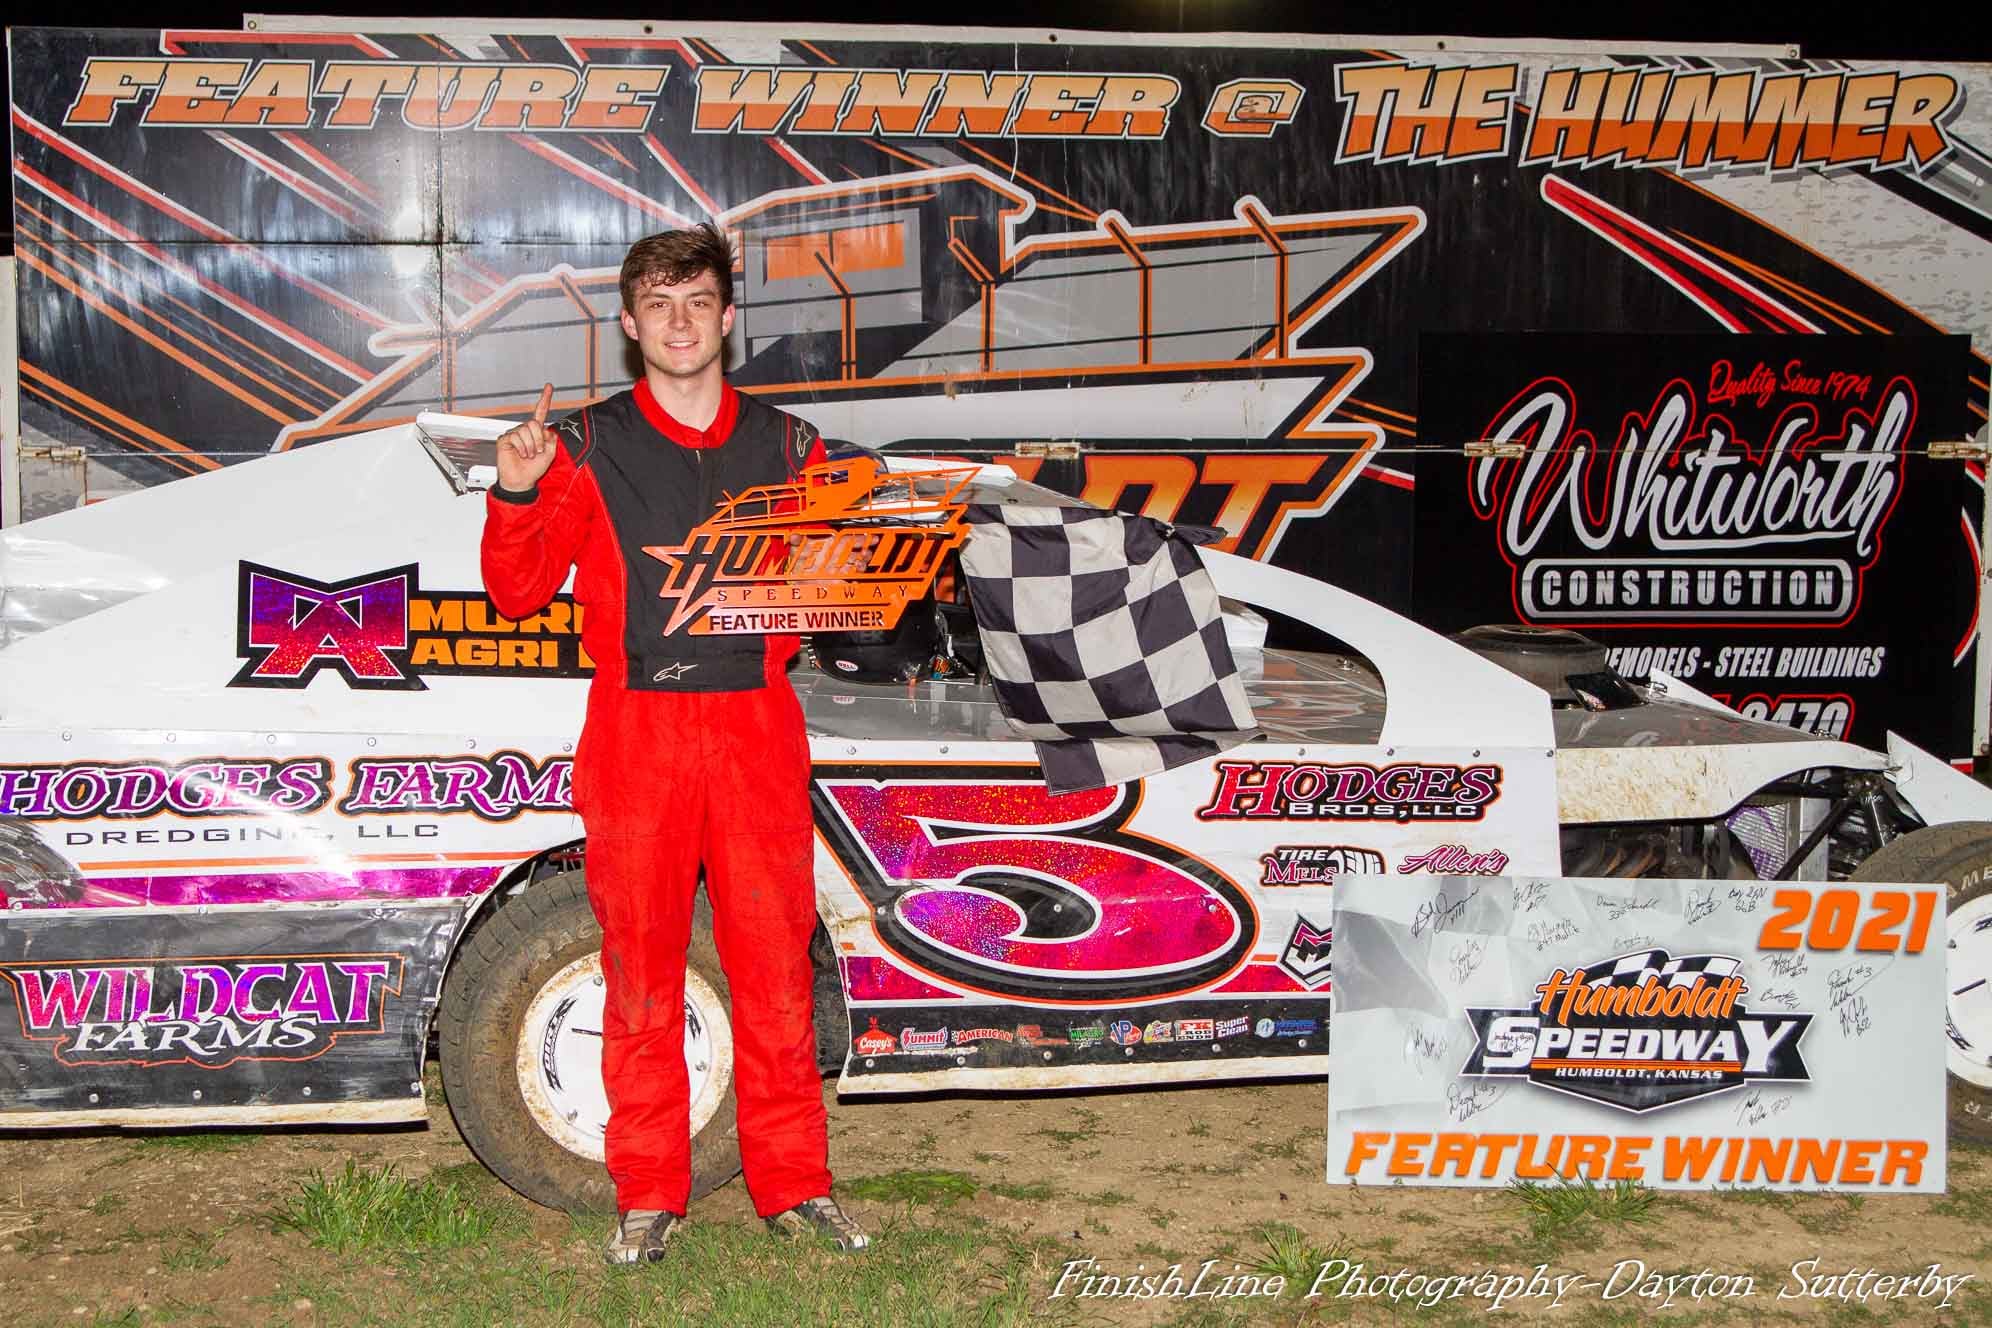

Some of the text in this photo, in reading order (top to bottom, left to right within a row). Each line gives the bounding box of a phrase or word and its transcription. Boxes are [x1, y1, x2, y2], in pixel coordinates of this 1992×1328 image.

[63, 56, 1965, 175] FEATURE WINNER @ THE HUMMER
[1707, 359, 1873, 408] Quality Since 1974
[1476, 391, 1909, 557] Whitworth
[717, 585, 908, 602] SPEEDWAY
[1541, 570, 1836, 606] CONSTRUCTION
[710, 611, 885, 631] FEATURE WINNER
[410, 638, 559, 668] AGRI
[1605, 647, 1700, 678] EMODELS
[1714, 647, 1772, 678] STEEL
[1775, 646, 1886, 678] BUILDINGS
[0, 762, 322, 816] HODGES
[1201, 763, 1495, 817] HODGES
[358, 824, 439, 838] LLC
[1279, 849, 1328, 861] TIRE
[1398, 845, 1509, 874] Allen's
[1758, 889, 1937, 953] 2021
[12, 961, 390, 1030] WILDCAT
[1536, 968, 1749, 1026] Humboldt
[65, 1014, 319, 1056] FARMS
[957, 1028, 1013, 1045] AMERICAN
[1216, 1016, 1249, 1030] Super
[1217, 1025, 1249, 1038] Clean
[860, 1037, 892, 1054] Casey's
[1483, 1015, 1798, 1073] SPEEDWAY
[1655, 1069, 1723, 1080] KANSAS
[1345, 1131, 1929, 1185] FEATURE WINNER
